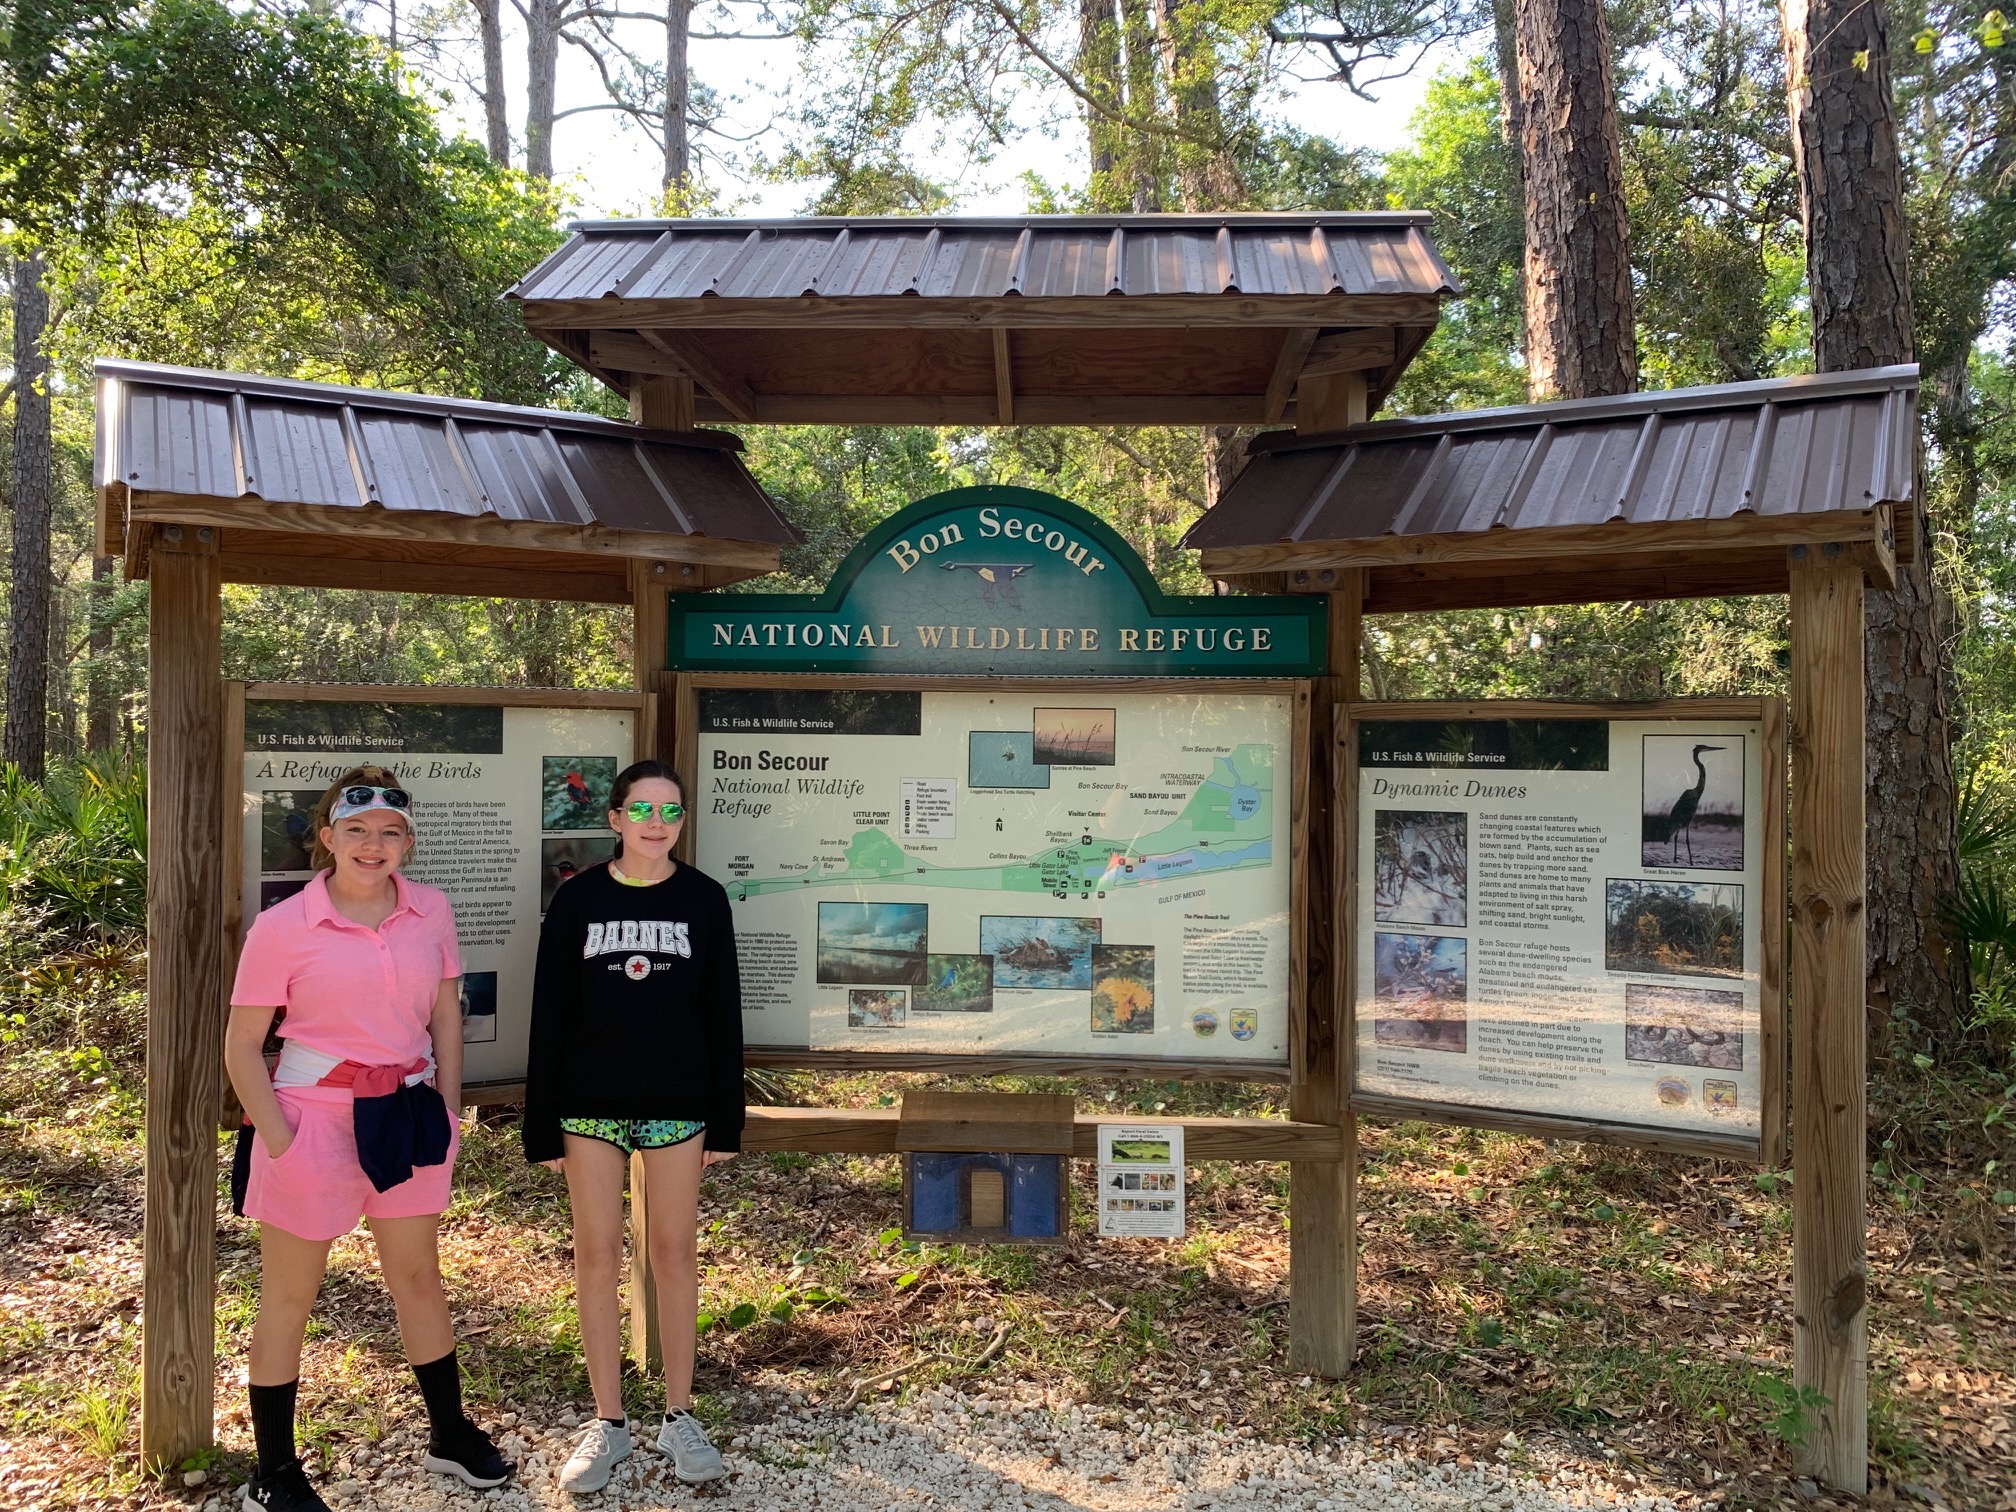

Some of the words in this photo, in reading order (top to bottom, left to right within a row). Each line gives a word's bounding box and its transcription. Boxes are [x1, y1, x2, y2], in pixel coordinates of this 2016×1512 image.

[887, 516, 964, 574] Bon
[978, 507, 1106, 577] Secour
[713, 623, 900, 648] NATIONAL
[916, 624, 1100, 651] WILDLIFE
[1119, 627, 1273, 651] REFUGE
[713, 718, 730, 727] U.S.
[733, 718, 751, 727] Fish
[753, 719, 760, 727] &
[763, 718, 798, 728] Wildlife
[800, 719, 834, 728] Service
[258, 735, 279, 744] U.S.
[283, 735, 304, 745] Fish
[307, 736, 316, 745] &
[319, 735, 362, 746] Wildlife
[365, 736, 404, 746] Service
[713, 750, 751, 770] Bon
[758, 750, 829, 771] Secour
[1373, 752, 1390, 761] U.S.
[1394, 752, 1412, 761] Fish
[1415, 752, 1423, 761] &
[1426, 752, 1465, 762] Wildlife
[1467, 753, 1505, 763] Service
[256, 761, 274, 778] A
[393, 762, 421, 778] the
[427, 762, 481, 779] Birds
[712, 777, 790, 794] National
[797, 778, 864, 799] Wildlife
[1115, 783, 1128, 791] Bay
[1372, 779, 1459, 799] Dynamic
[1464, 780, 1527, 798] Dunes
[1238, 799, 1256, 807] Oyster
[711, 799, 771, 818] Refuge
[1241, 805, 1253, 813] Bay
[1539, 815, 1578, 823] constantly
[996, 823, 1003, 832] N
[1480, 823, 1513, 831] changing
[1544, 824, 1575, 832] features
[837, 839, 849, 847] Bay
[1522, 833, 1530, 841] by
[1546, 835, 1597, 843] accumulation
[1527, 843, 1552, 852] Plants,
[1008, 853, 1026, 861] Bayou
[1499, 852, 1514, 860] help
[780, 863, 794, 871] Navy
[823, 862, 835, 870] Bay
[1173, 859, 1192, 869] Lagoon
[1159, 896, 1174, 904] GULF
[1184, 889, 1206, 901] MEXICO
[584, 920, 691, 959] BARNES
[1496, 940, 1521, 948] Secour
[1524, 942, 1548, 951] refuge
[1550, 944, 1570, 952] hosts
[1479, 1025, 1514, 1035] increased
[1517, 1030, 1564, 1040] development
[1567, 1035, 1587, 1044] along
